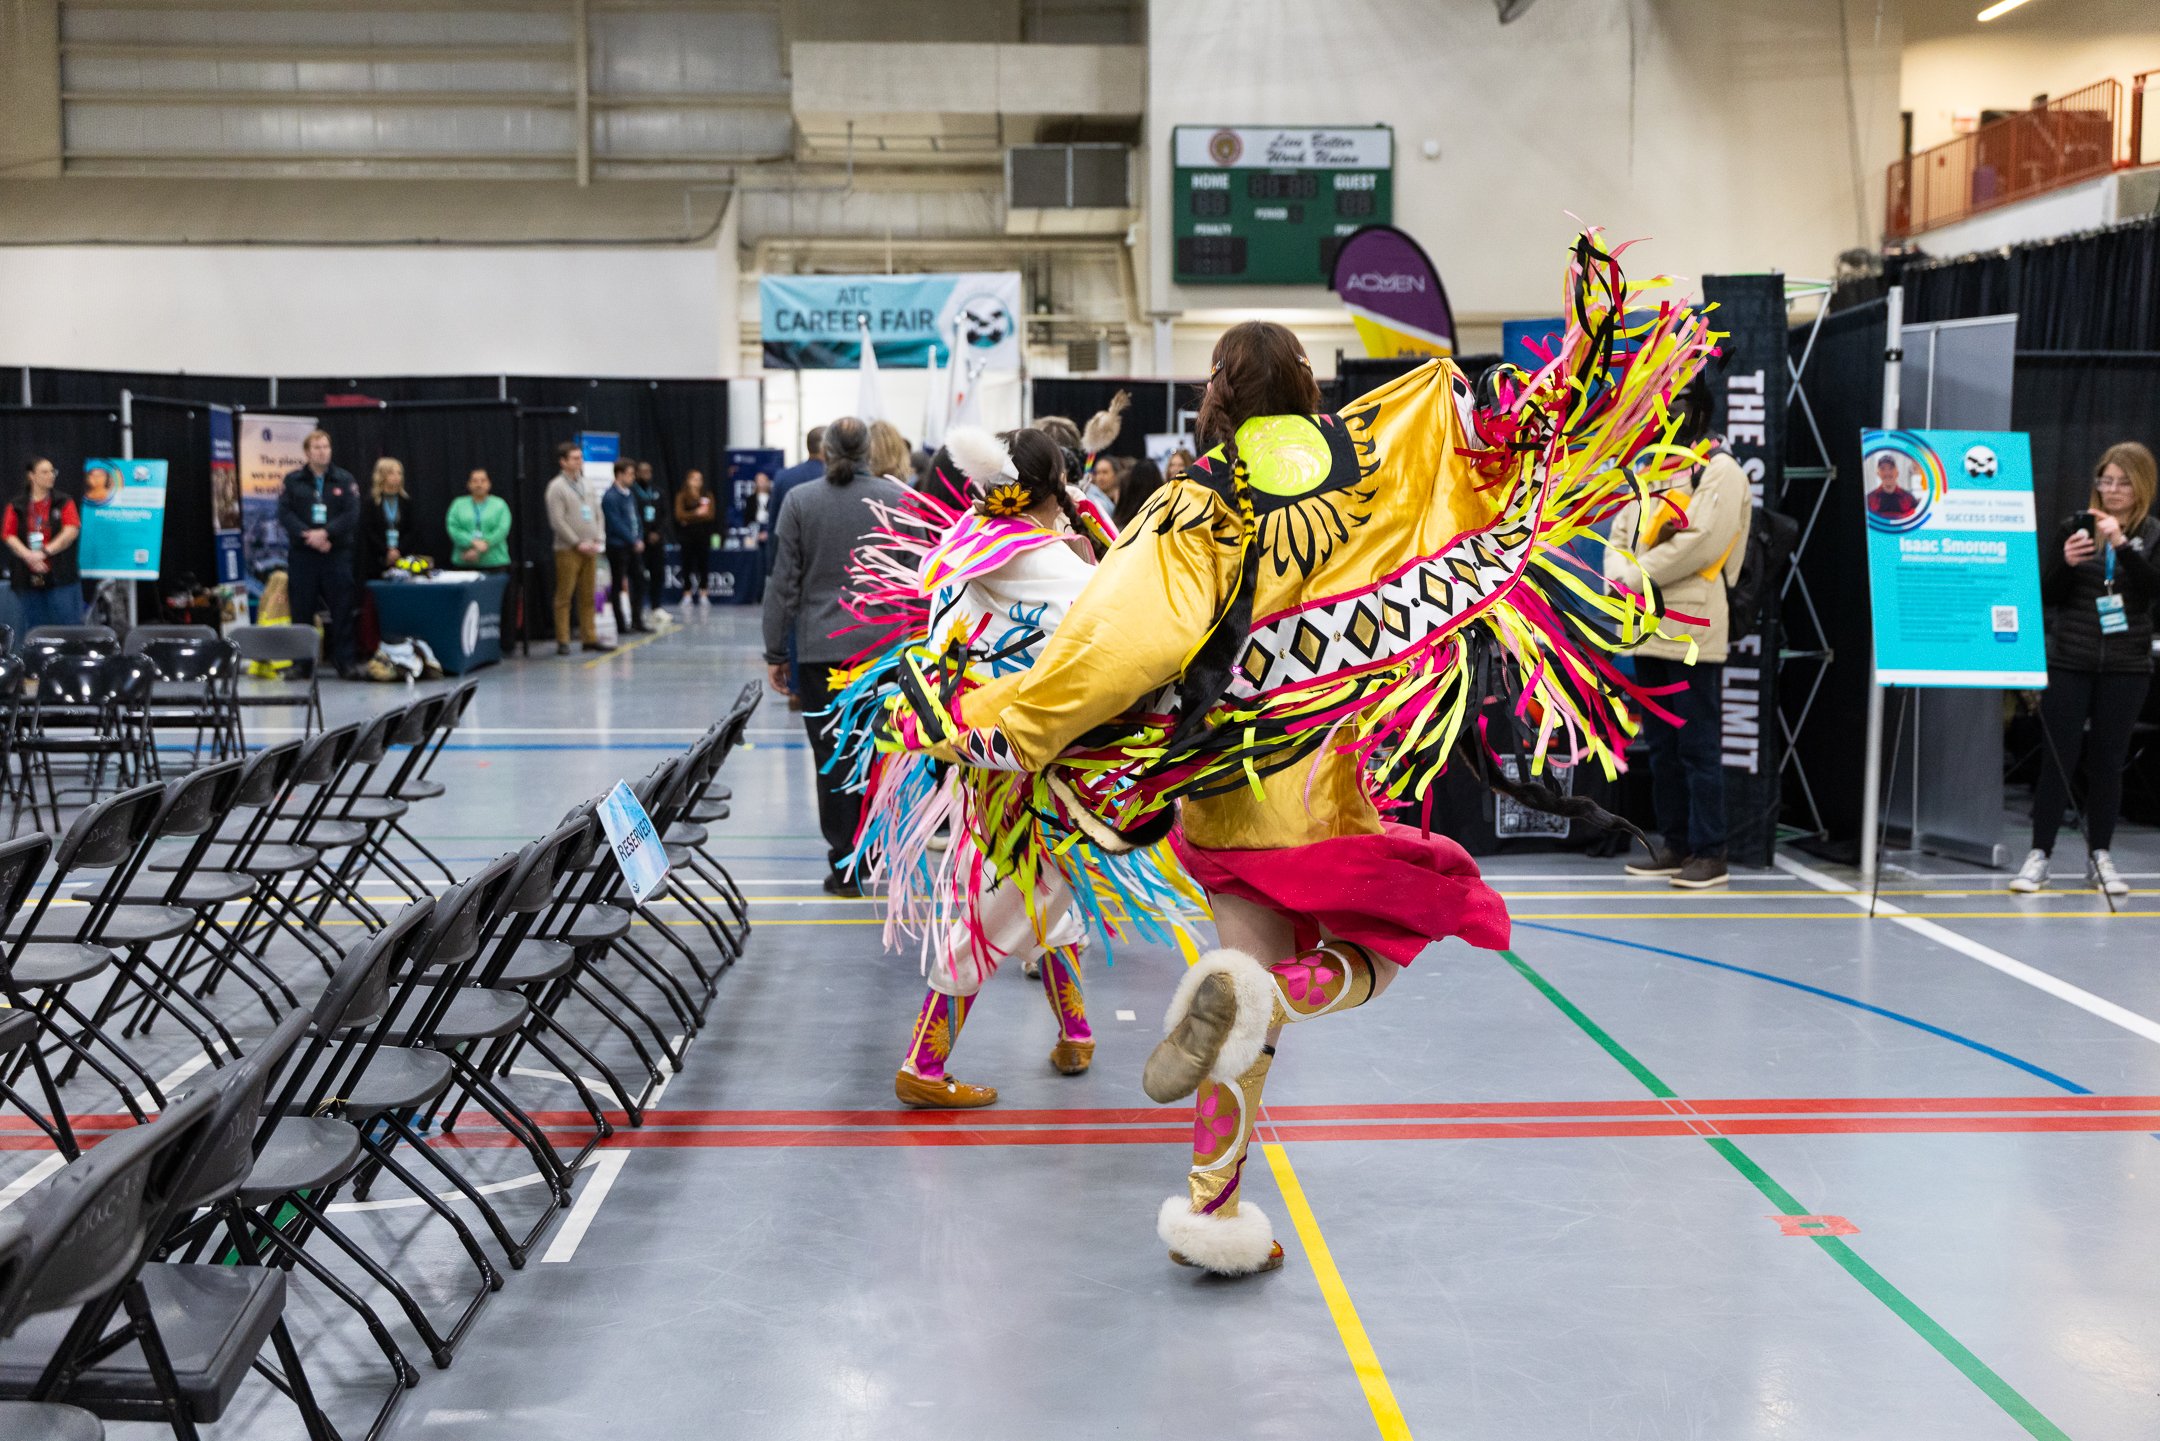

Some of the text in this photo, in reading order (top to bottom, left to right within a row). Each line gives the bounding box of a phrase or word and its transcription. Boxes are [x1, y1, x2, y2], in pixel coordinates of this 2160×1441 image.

[1191, 173, 1230, 189] HOME
[1333, 173, 1377, 190] GUEST
[1254, 207, 1288, 220] PERIOD
[1193, 223, 1233, 236] PENALTY
[836, 286, 871, 306] ATC
[775, 308, 935, 332] CAREER FAIR
[1728, 369, 1766, 447] THE
[1945, 513, 2025, 524] SUCCESS STORIES
[1899, 536, 2007, 557] Isaac Smorong
[1721, 667, 1760, 774] LIMIT
[616, 817, 652, 862] RESERVED
